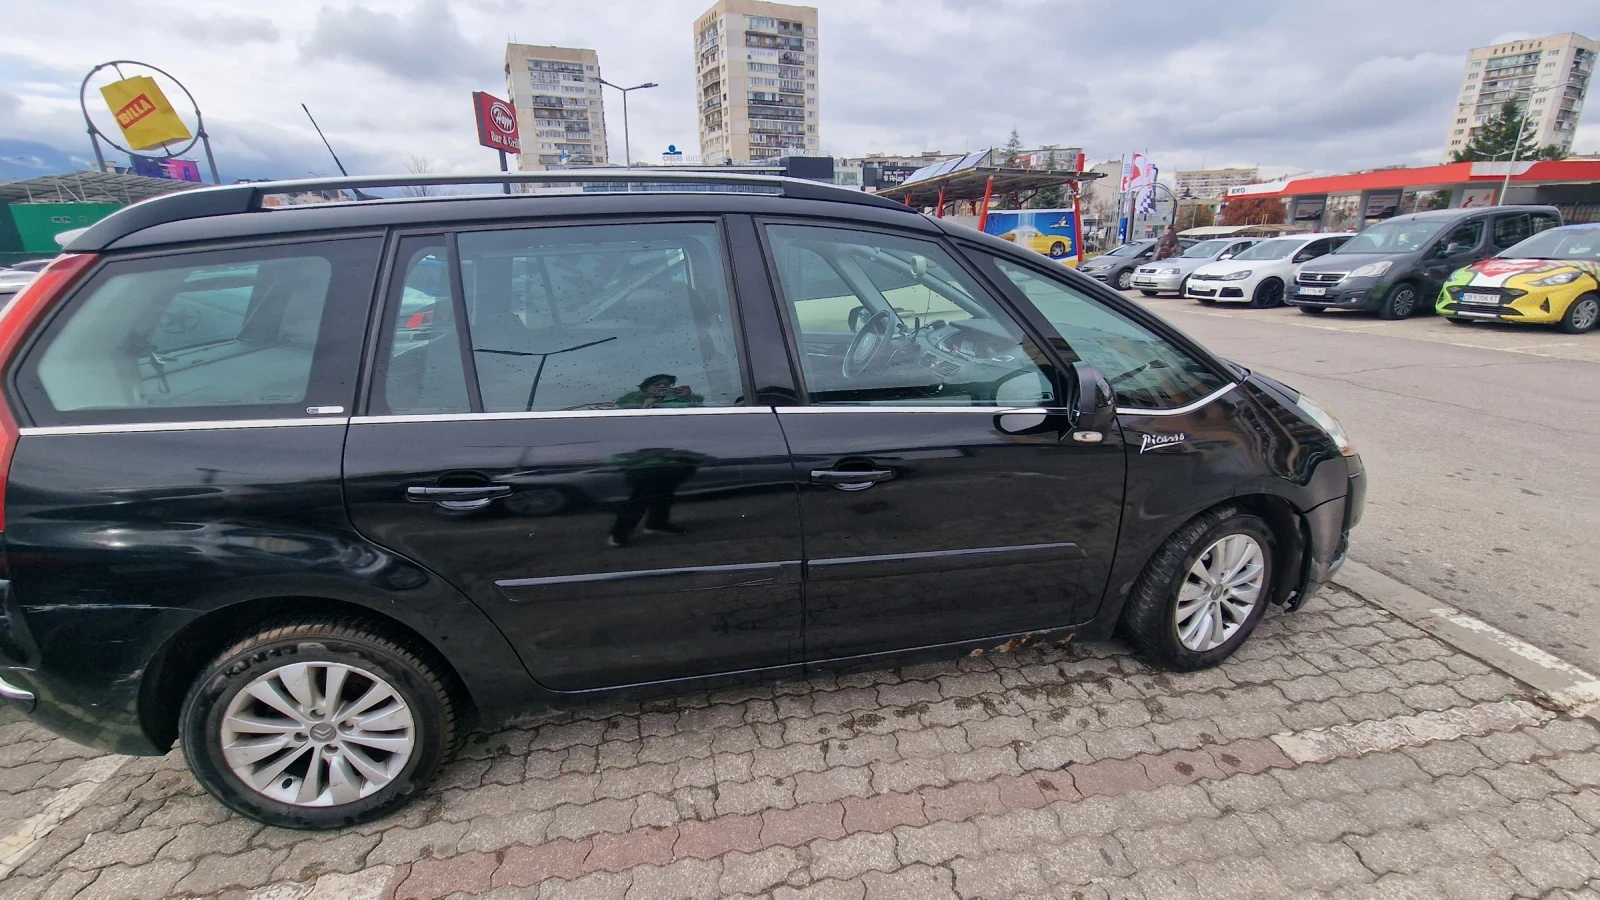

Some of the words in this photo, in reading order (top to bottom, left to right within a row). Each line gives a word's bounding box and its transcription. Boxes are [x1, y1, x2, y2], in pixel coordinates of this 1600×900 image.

[118, 99, 152, 125] BILLA
[493, 107, 513, 130] Happy
[490, 130, 502, 144] Bar
[503, 135, 508, 145] &
[1140, 433, 1185, 455] Picasso
